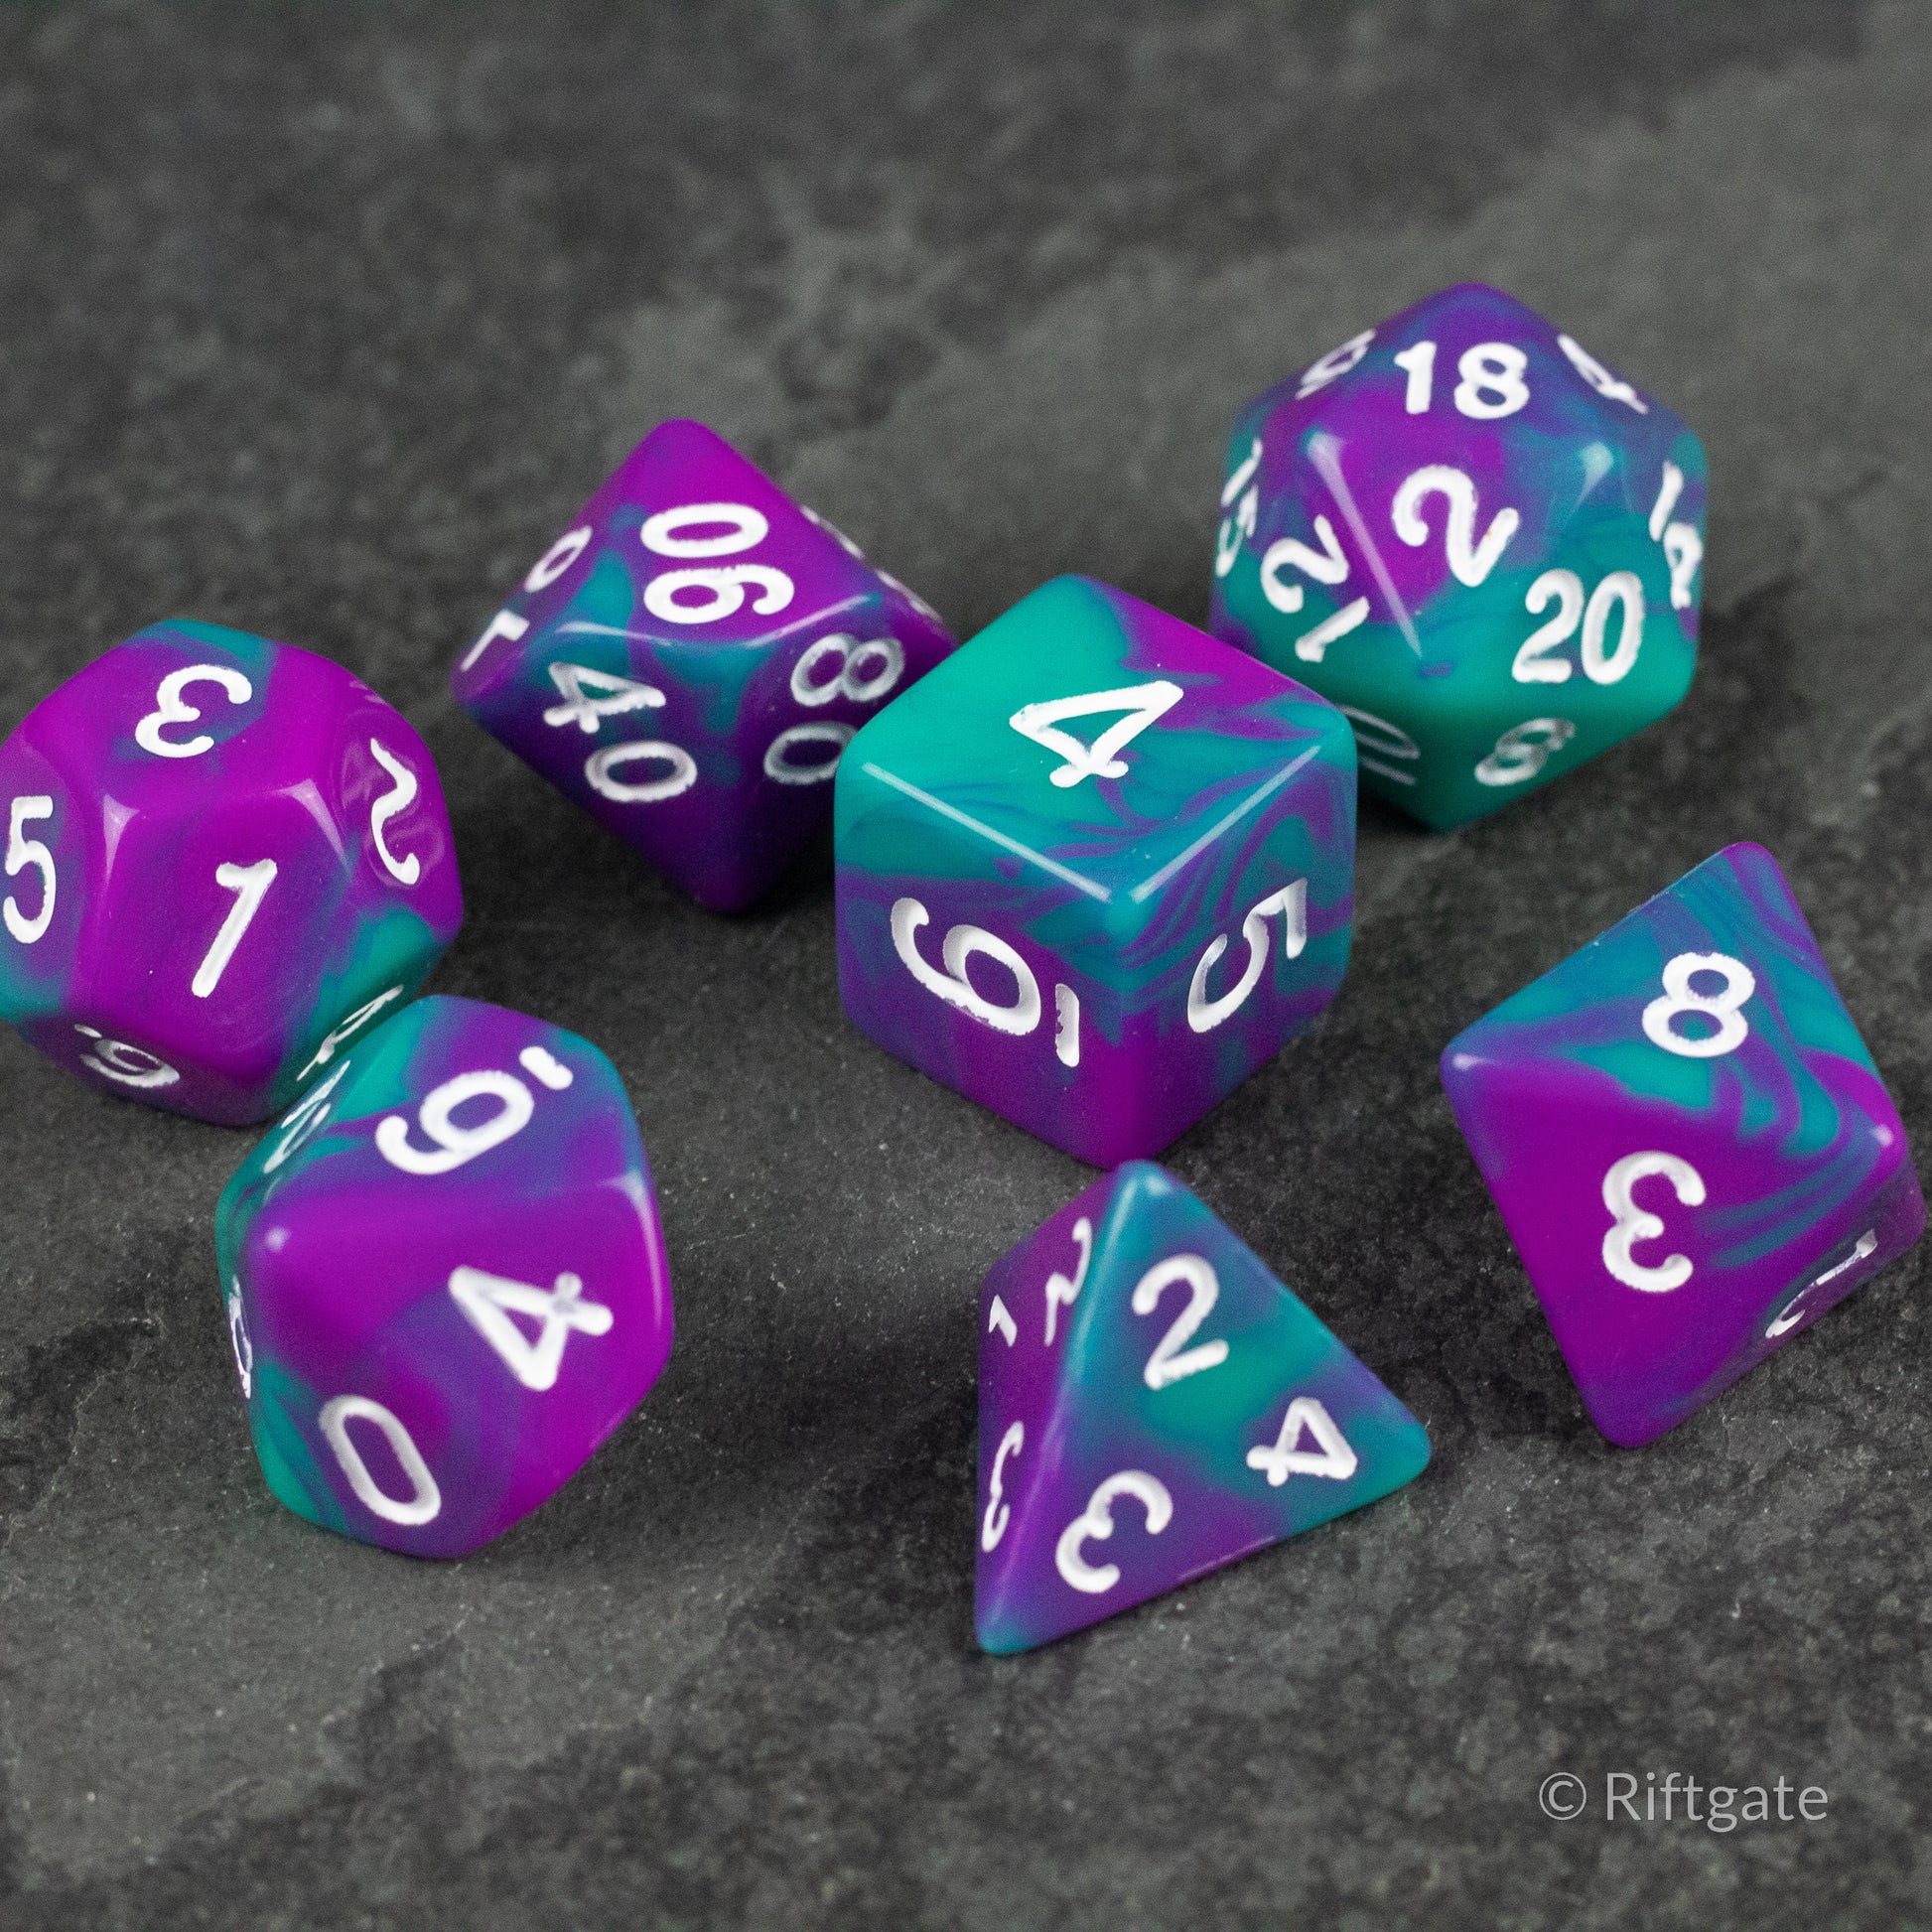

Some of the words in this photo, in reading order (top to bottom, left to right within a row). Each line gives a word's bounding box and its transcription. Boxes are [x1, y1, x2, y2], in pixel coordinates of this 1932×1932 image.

[1395, 342, 1529, 419] 18
[640, 503, 794, 623] 90
[1392, 466, 1519, 587] 2
[1261, 515, 1370, 662] 12
[1512, 570, 1644, 684] 20
[135, 664, 252, 758] 3
[544, 663, 697, 802] 40
[1010, 680, 1183, 787] 4
[3, 796, 56, 943] 5
[370, 739, 420, 885] 2
[192, 859, 277, 998] 1
[1187, 882, 1307, 1033] 5
[1642, 952, 1755, 1057] 8
[1602, 1152, 1706, 1292] 3
[449, 1268, 613, 1391] 4
[1132, 1256, 1228, 1389] 2
[320, 1397, 441, 1525] 0
[1247, 1398, 1357, 1486] 4
[1056, 1471, 1173, 1592] 3
